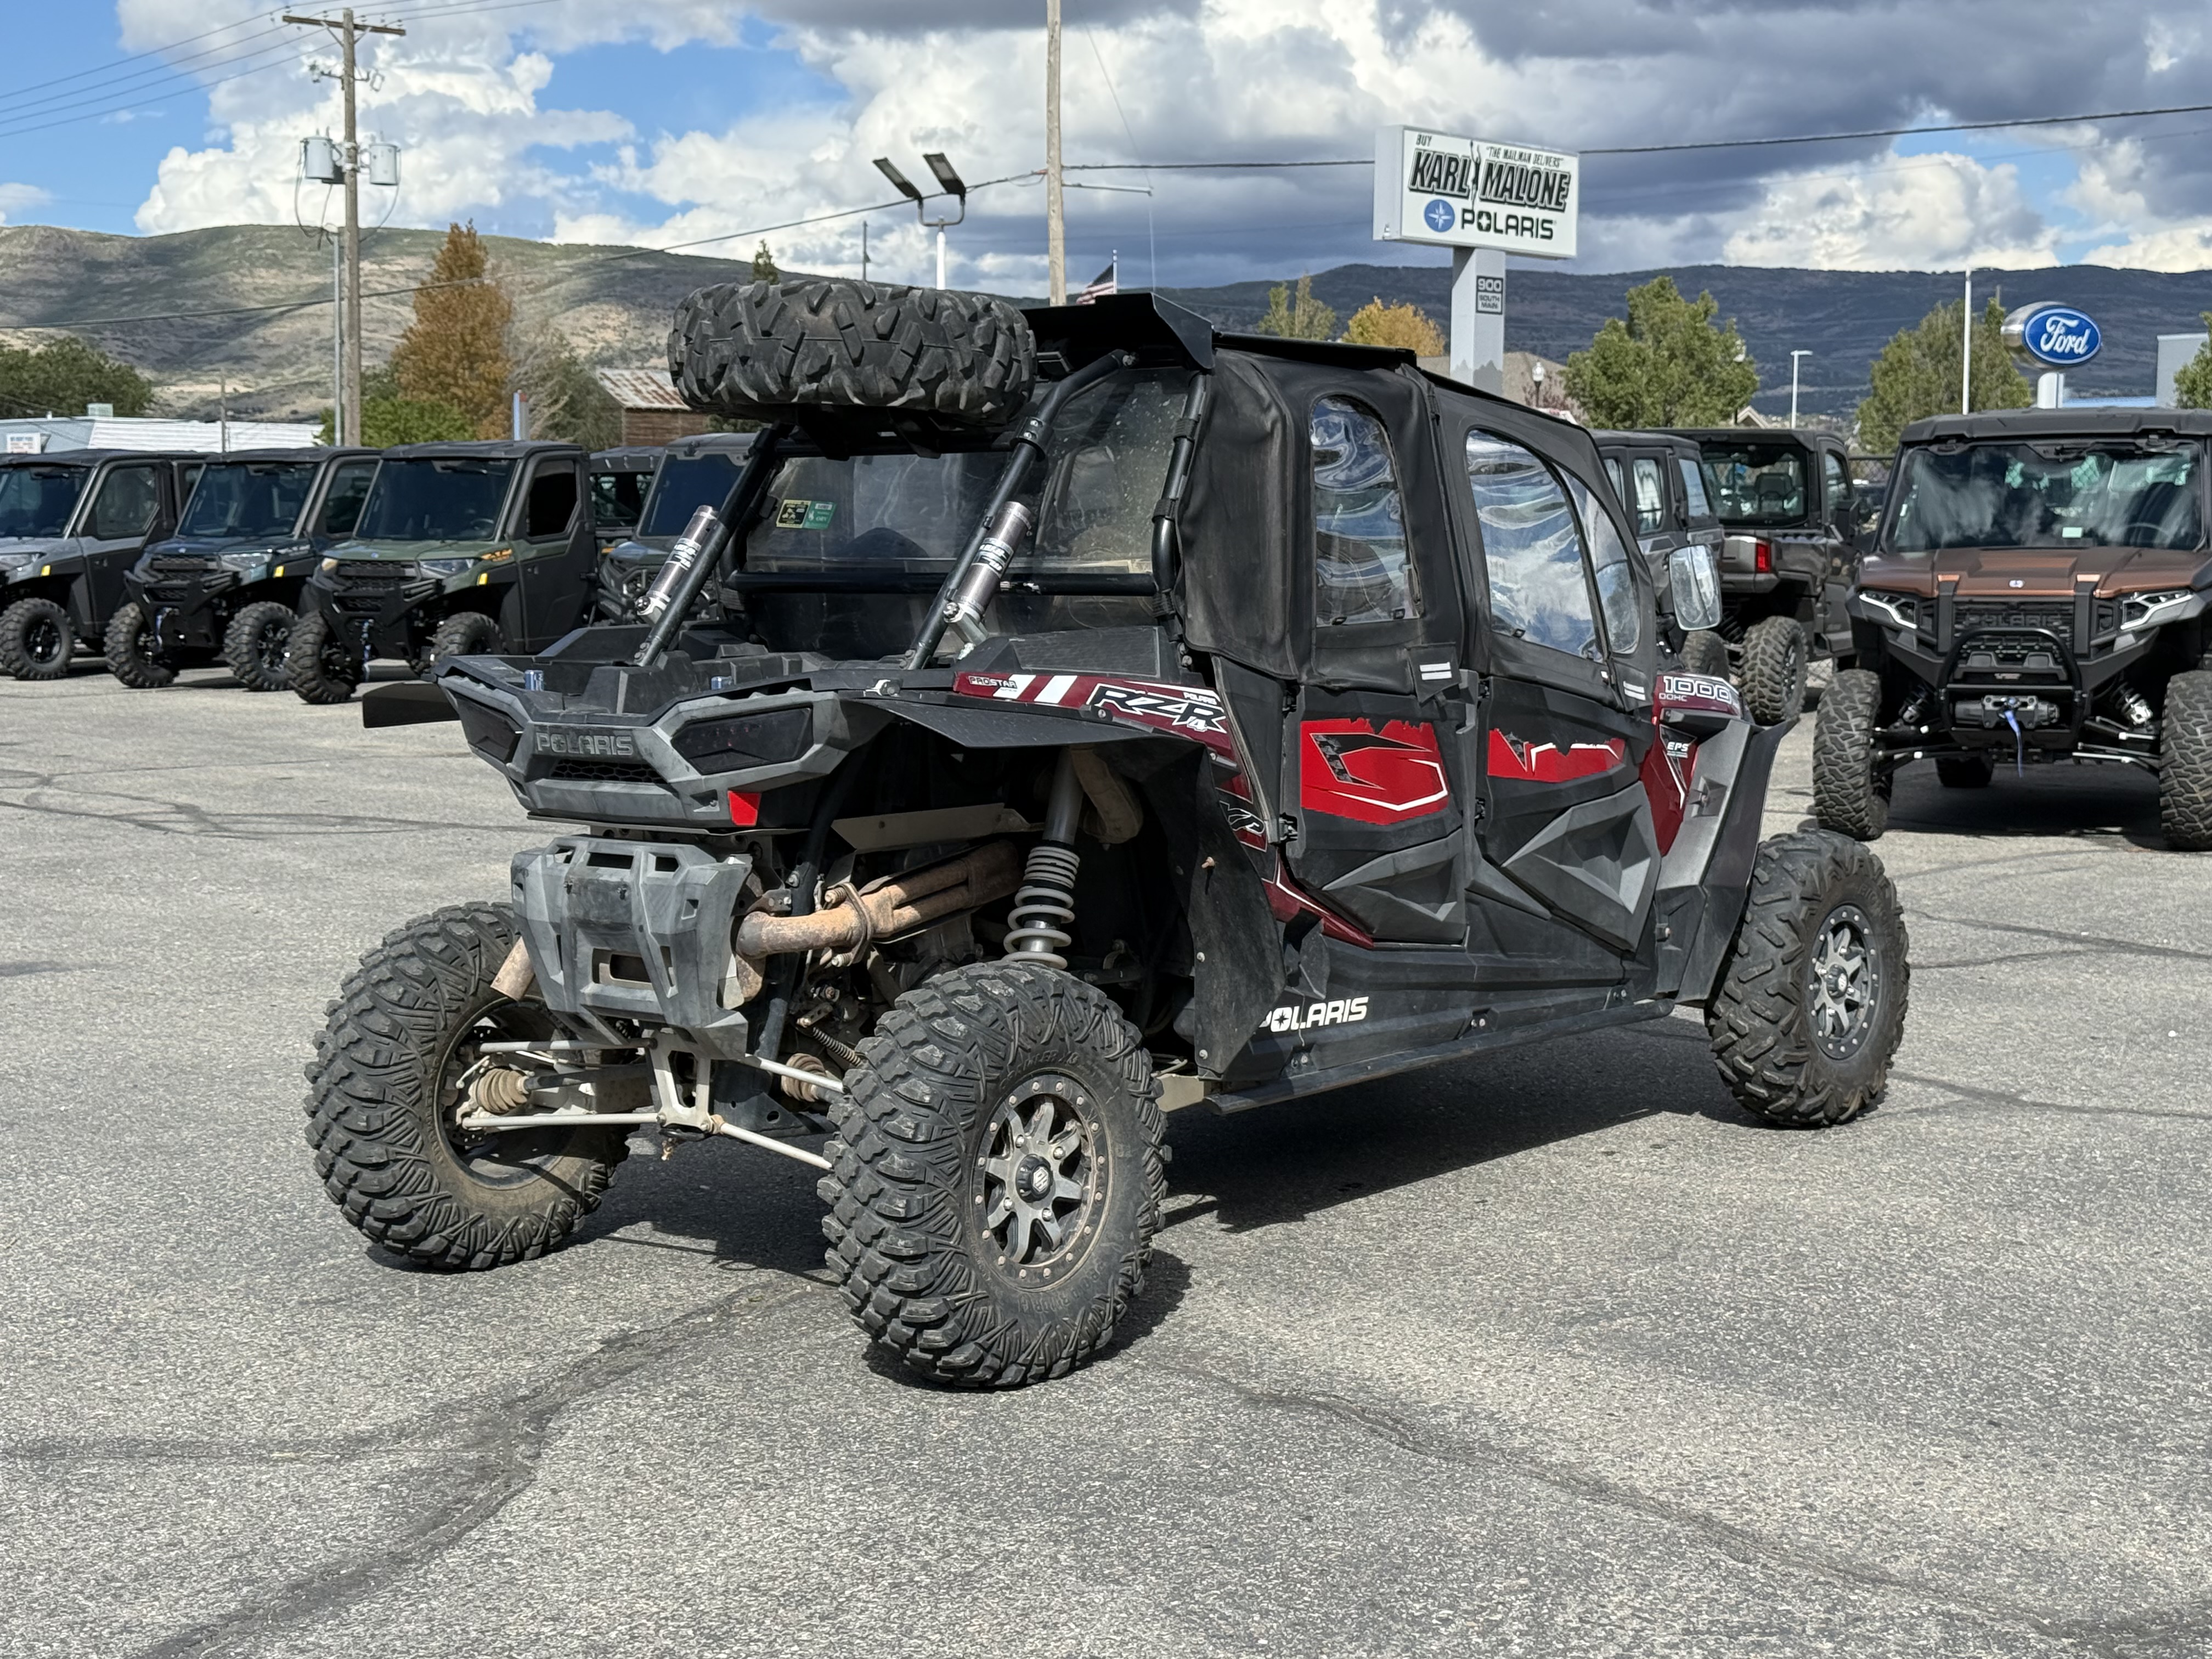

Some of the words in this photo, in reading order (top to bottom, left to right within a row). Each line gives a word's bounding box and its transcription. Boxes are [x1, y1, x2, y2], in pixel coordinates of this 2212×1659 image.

[1416, 134, 1432, 146] BUY
[1502, 149, 1531, 163] MAILMAN
[1408, 148, 1471, 199] KARL
[1479, 159, 1571, 213] MALONE
[1460, 208, 1554, 240] POLARIS
[1478, 278, 1502, 292] 900
[2040, 316, 2091, 354] Ford
[968, 675, 1018, 689] PROSTAR
[1663, 676, 1731, 704] 1000
[1183, 692, 1218, 706] POLARIS
[1659, 693, 1688, 702] DOHC
[535, 732, 634, 755] POLARIS
[1667, 742, 1690, 752] EPS
